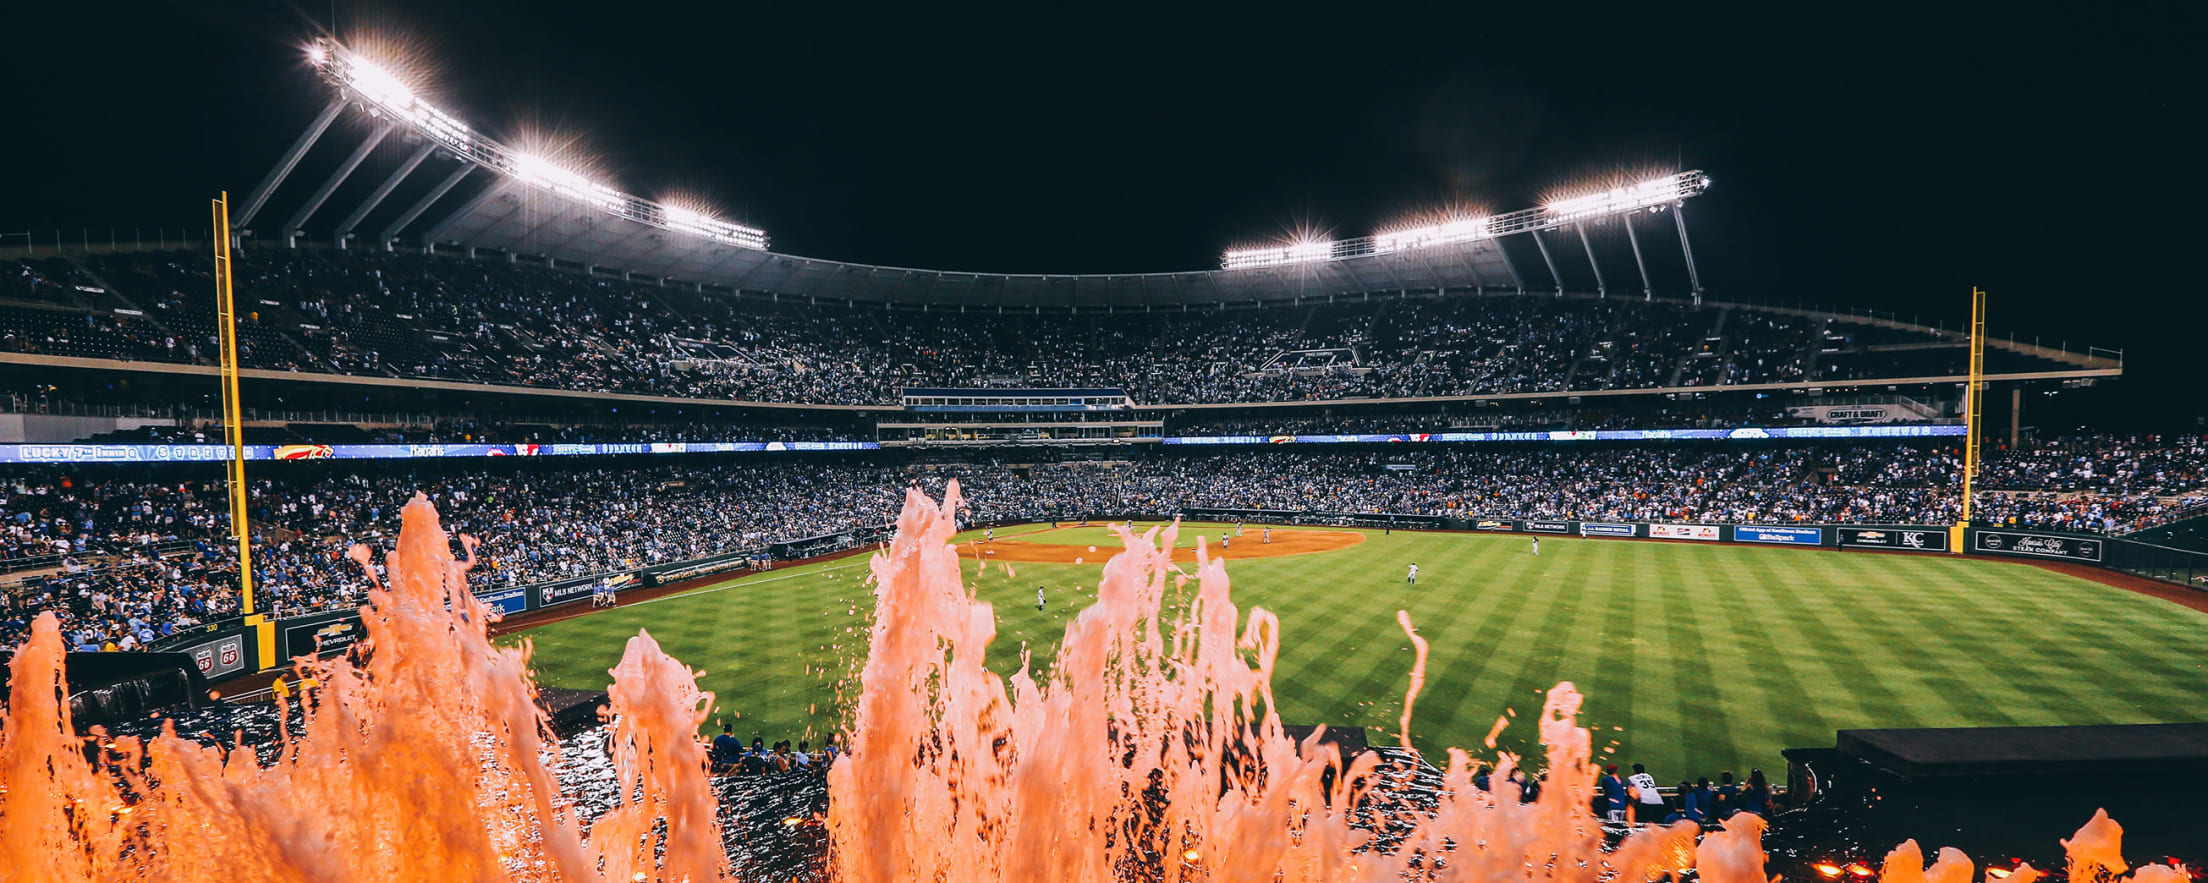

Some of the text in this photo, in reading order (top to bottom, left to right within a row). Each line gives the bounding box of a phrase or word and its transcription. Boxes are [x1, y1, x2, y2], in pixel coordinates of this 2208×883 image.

[1830, 411, 1852, 419] CRAFT
[1861, 410, 1884, 418] DRAFT
[21, 445, 70, 460] LUCKY
[1902, 532, 1924, 548] KC
[2012, 545, 2069, 556] STEAK COMPANY
[554, 583, 594, 597] MLB NETWORK
[223, 651, 235, 663] 66
[199, 658, 210, 670] 66
[1640, 780, 1656, 789] 35
